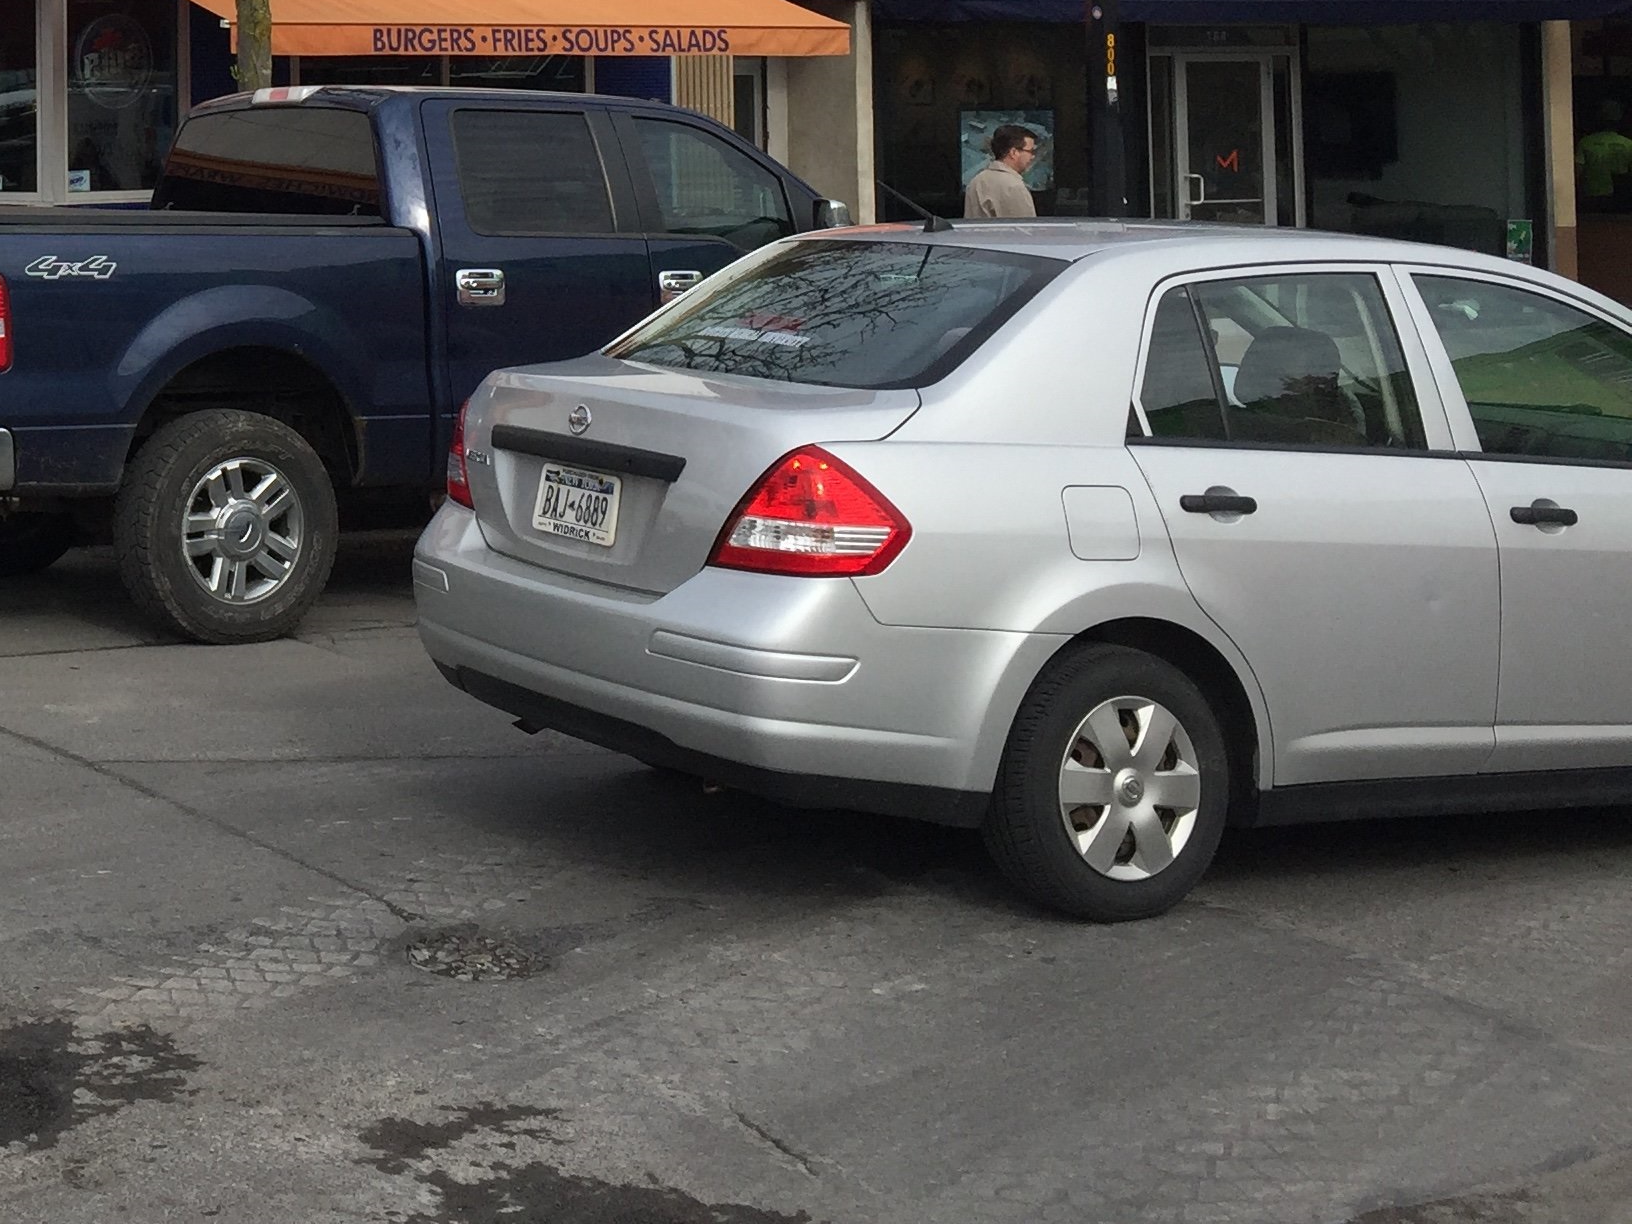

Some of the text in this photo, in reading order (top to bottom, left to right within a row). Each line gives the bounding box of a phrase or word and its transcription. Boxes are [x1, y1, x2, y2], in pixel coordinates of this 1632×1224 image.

[372, 28, 730, 53] BURGERS FRIES SOUPS SALADS
[24, 255, 117, 280] 4x4
